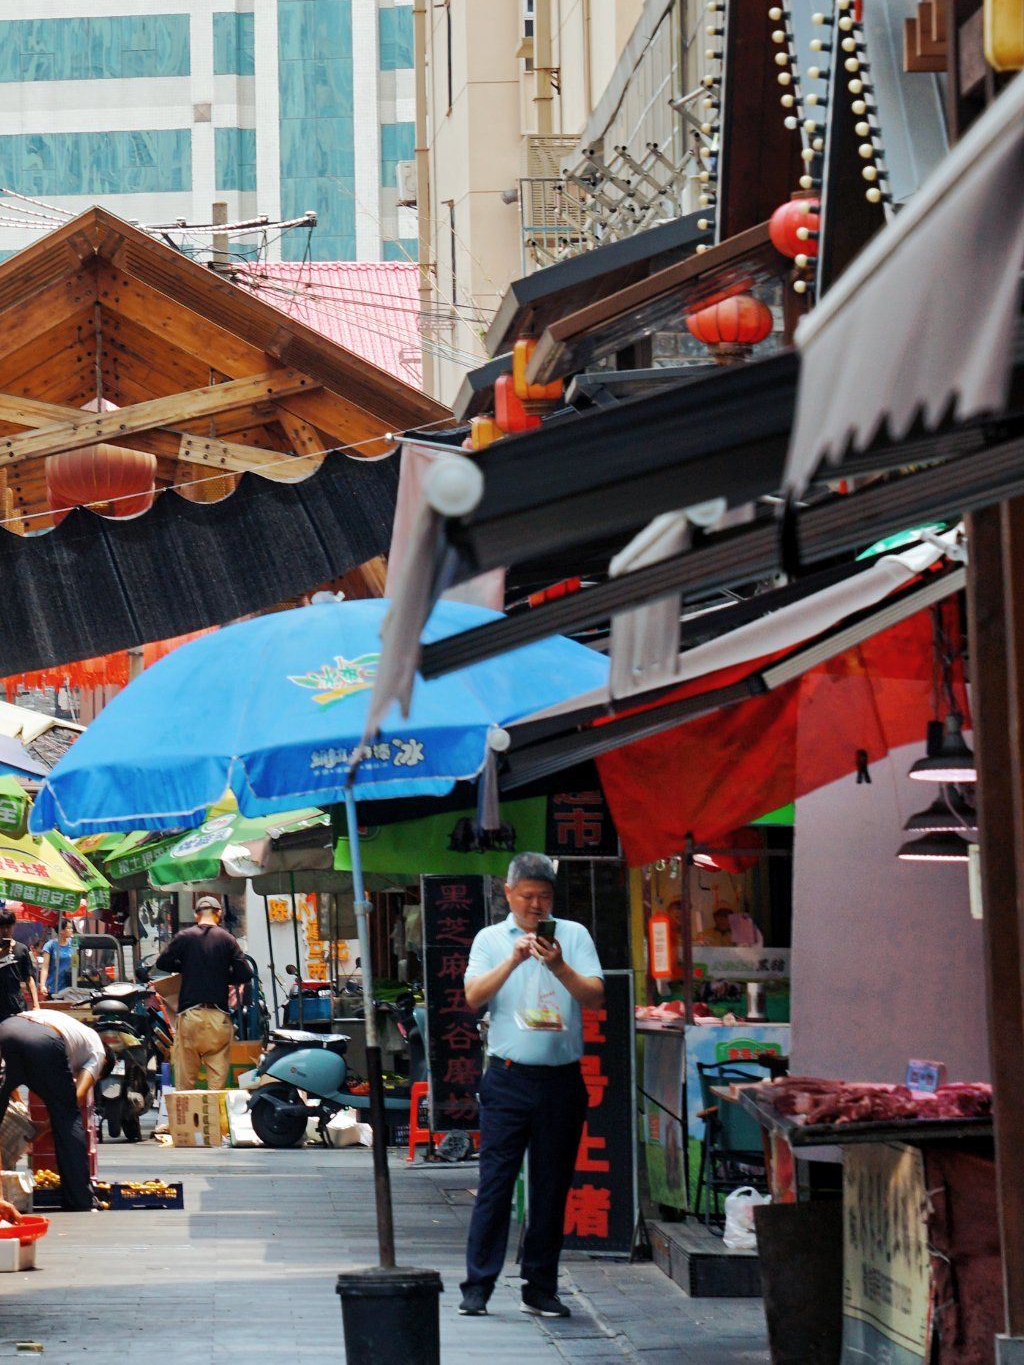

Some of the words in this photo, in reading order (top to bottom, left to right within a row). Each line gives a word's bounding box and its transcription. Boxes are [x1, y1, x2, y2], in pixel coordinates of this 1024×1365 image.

[435, 884, 480, 1121] 黑芝麻五谷磨坊
